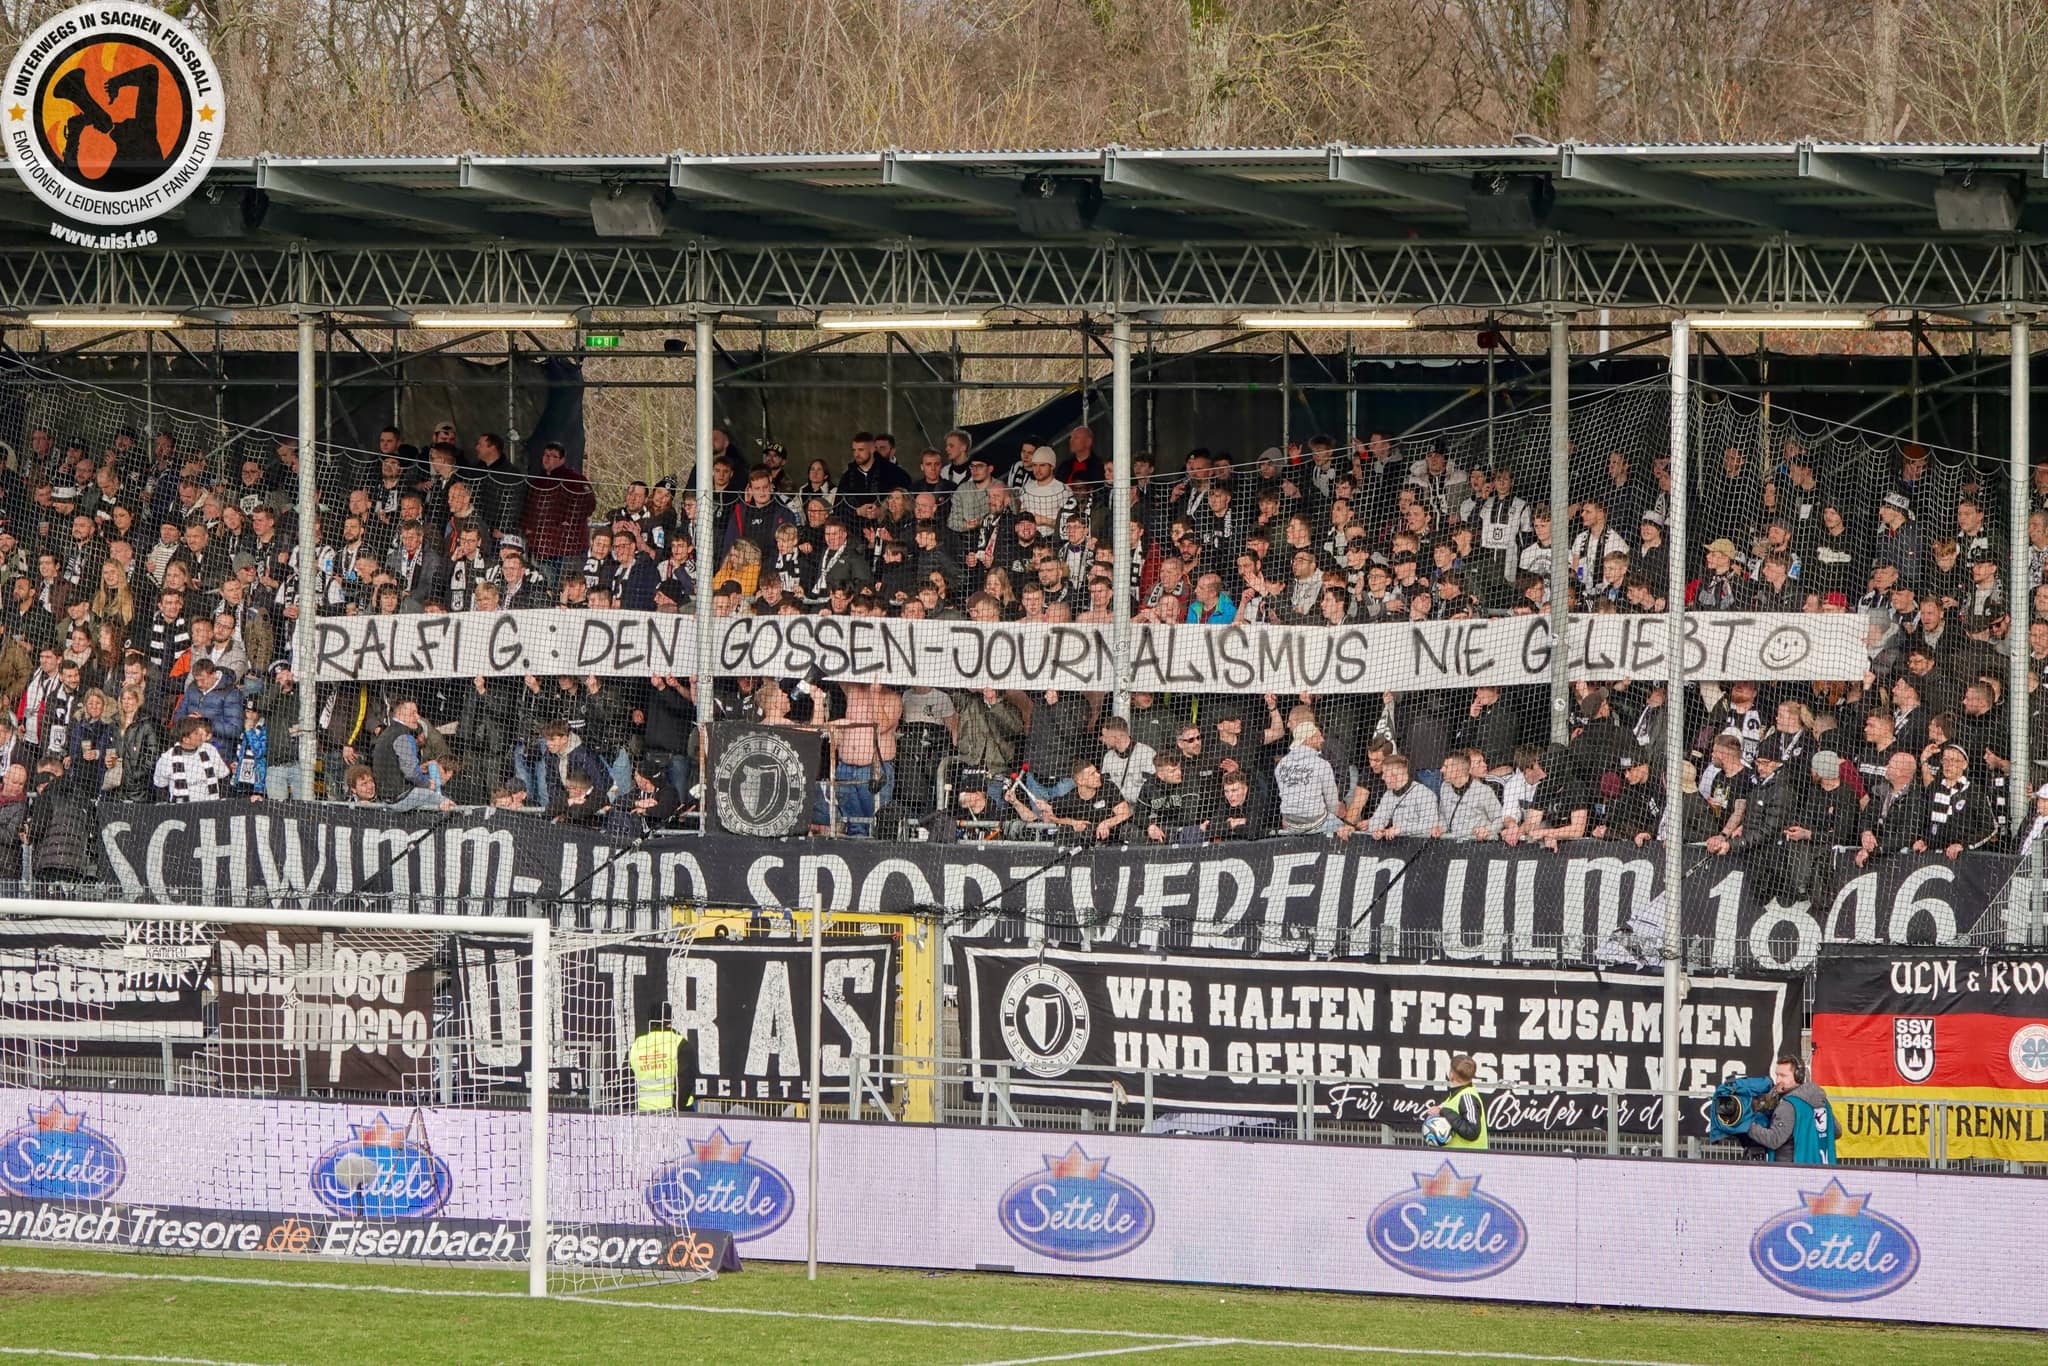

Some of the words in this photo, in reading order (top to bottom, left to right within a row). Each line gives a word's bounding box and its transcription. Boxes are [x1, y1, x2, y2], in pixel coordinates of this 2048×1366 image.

[316, 617, 460, 678] RALFI
[577, 617, 682, 668] DEN
[1413, 623, 1495, 677] NIE
[219, 930, 408, 1004] nebulosa
[1890, 960, 1958, 1001] ULM
[1967, 970, 1980, 993] &
[1989, 960, 2048, 996] RW
[465, 947, 876, 1076] ULTRAS
[1106, 975, 1194, 1024] WIR
[1208, 983, 1377, 1032] HALTEN
[1389, 989, 1503, 1039] FEST
[1896, 1018, 1934, 1034] SSV
[283, 990, 428, 1083] impero
[1114, 1031, 1210, 1080] UND
[1227, 1042, 1381, 1087] GEHEN
[1895, 1033, 1933, 1050] 1846
[1328, 1083, 1384, 1121] Für
[1487, 1089, 1582, 1130] Brüder
[4, 1136, 108, 1184] Settele
[662, 1167, 777, 1217] Settele
[1014, 1183, 1137, 1235] Settele
[320, 1221, 516, 1261] Eisenbach
[1382, 1201, 1510, 1254] Settele
[1768, 1221, 1901, 1274] Settele
